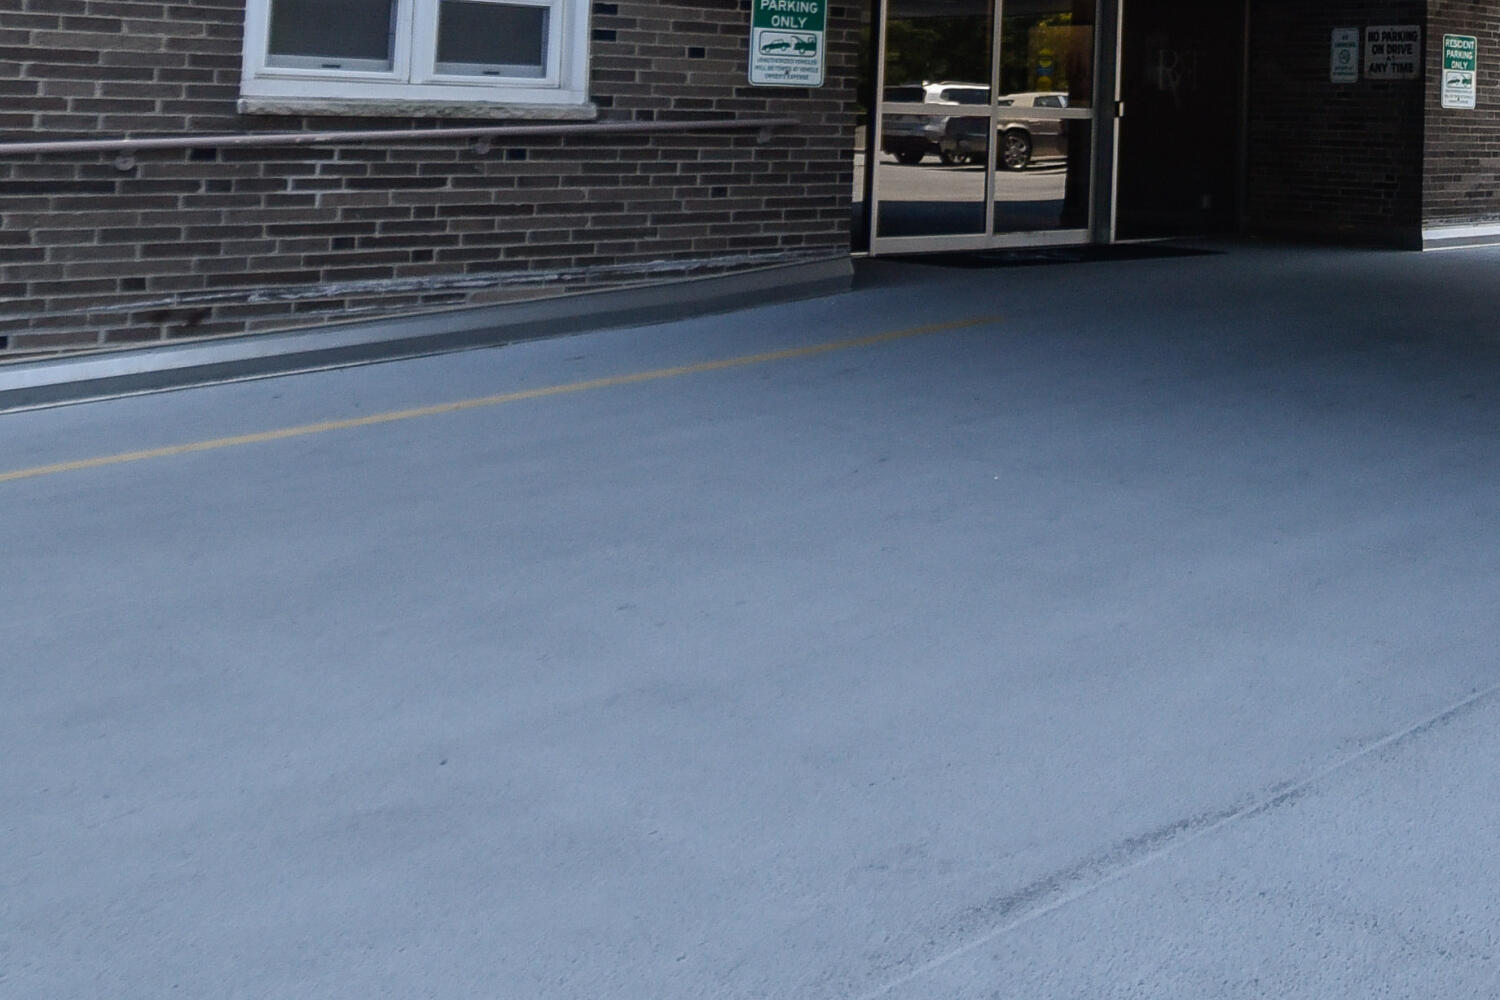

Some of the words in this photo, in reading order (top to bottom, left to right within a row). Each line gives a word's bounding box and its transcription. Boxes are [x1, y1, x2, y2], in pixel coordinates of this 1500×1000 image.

[771, 15, 808, 28] ONLY
[1368, 31, 1379, 42] NO
[1381, 31, 1418, 42] PARKING
[1387, 43, 1413, 55] DRIVE
[1445, 39, 1475, 50] RESIDENT
[1446, 49, 1473, 60] PARKING
[1369, 63, 1387, 73] ANY
[1391, 63, 1413, 73] TIME
[1451, 61, 1468, 69] ONLY
